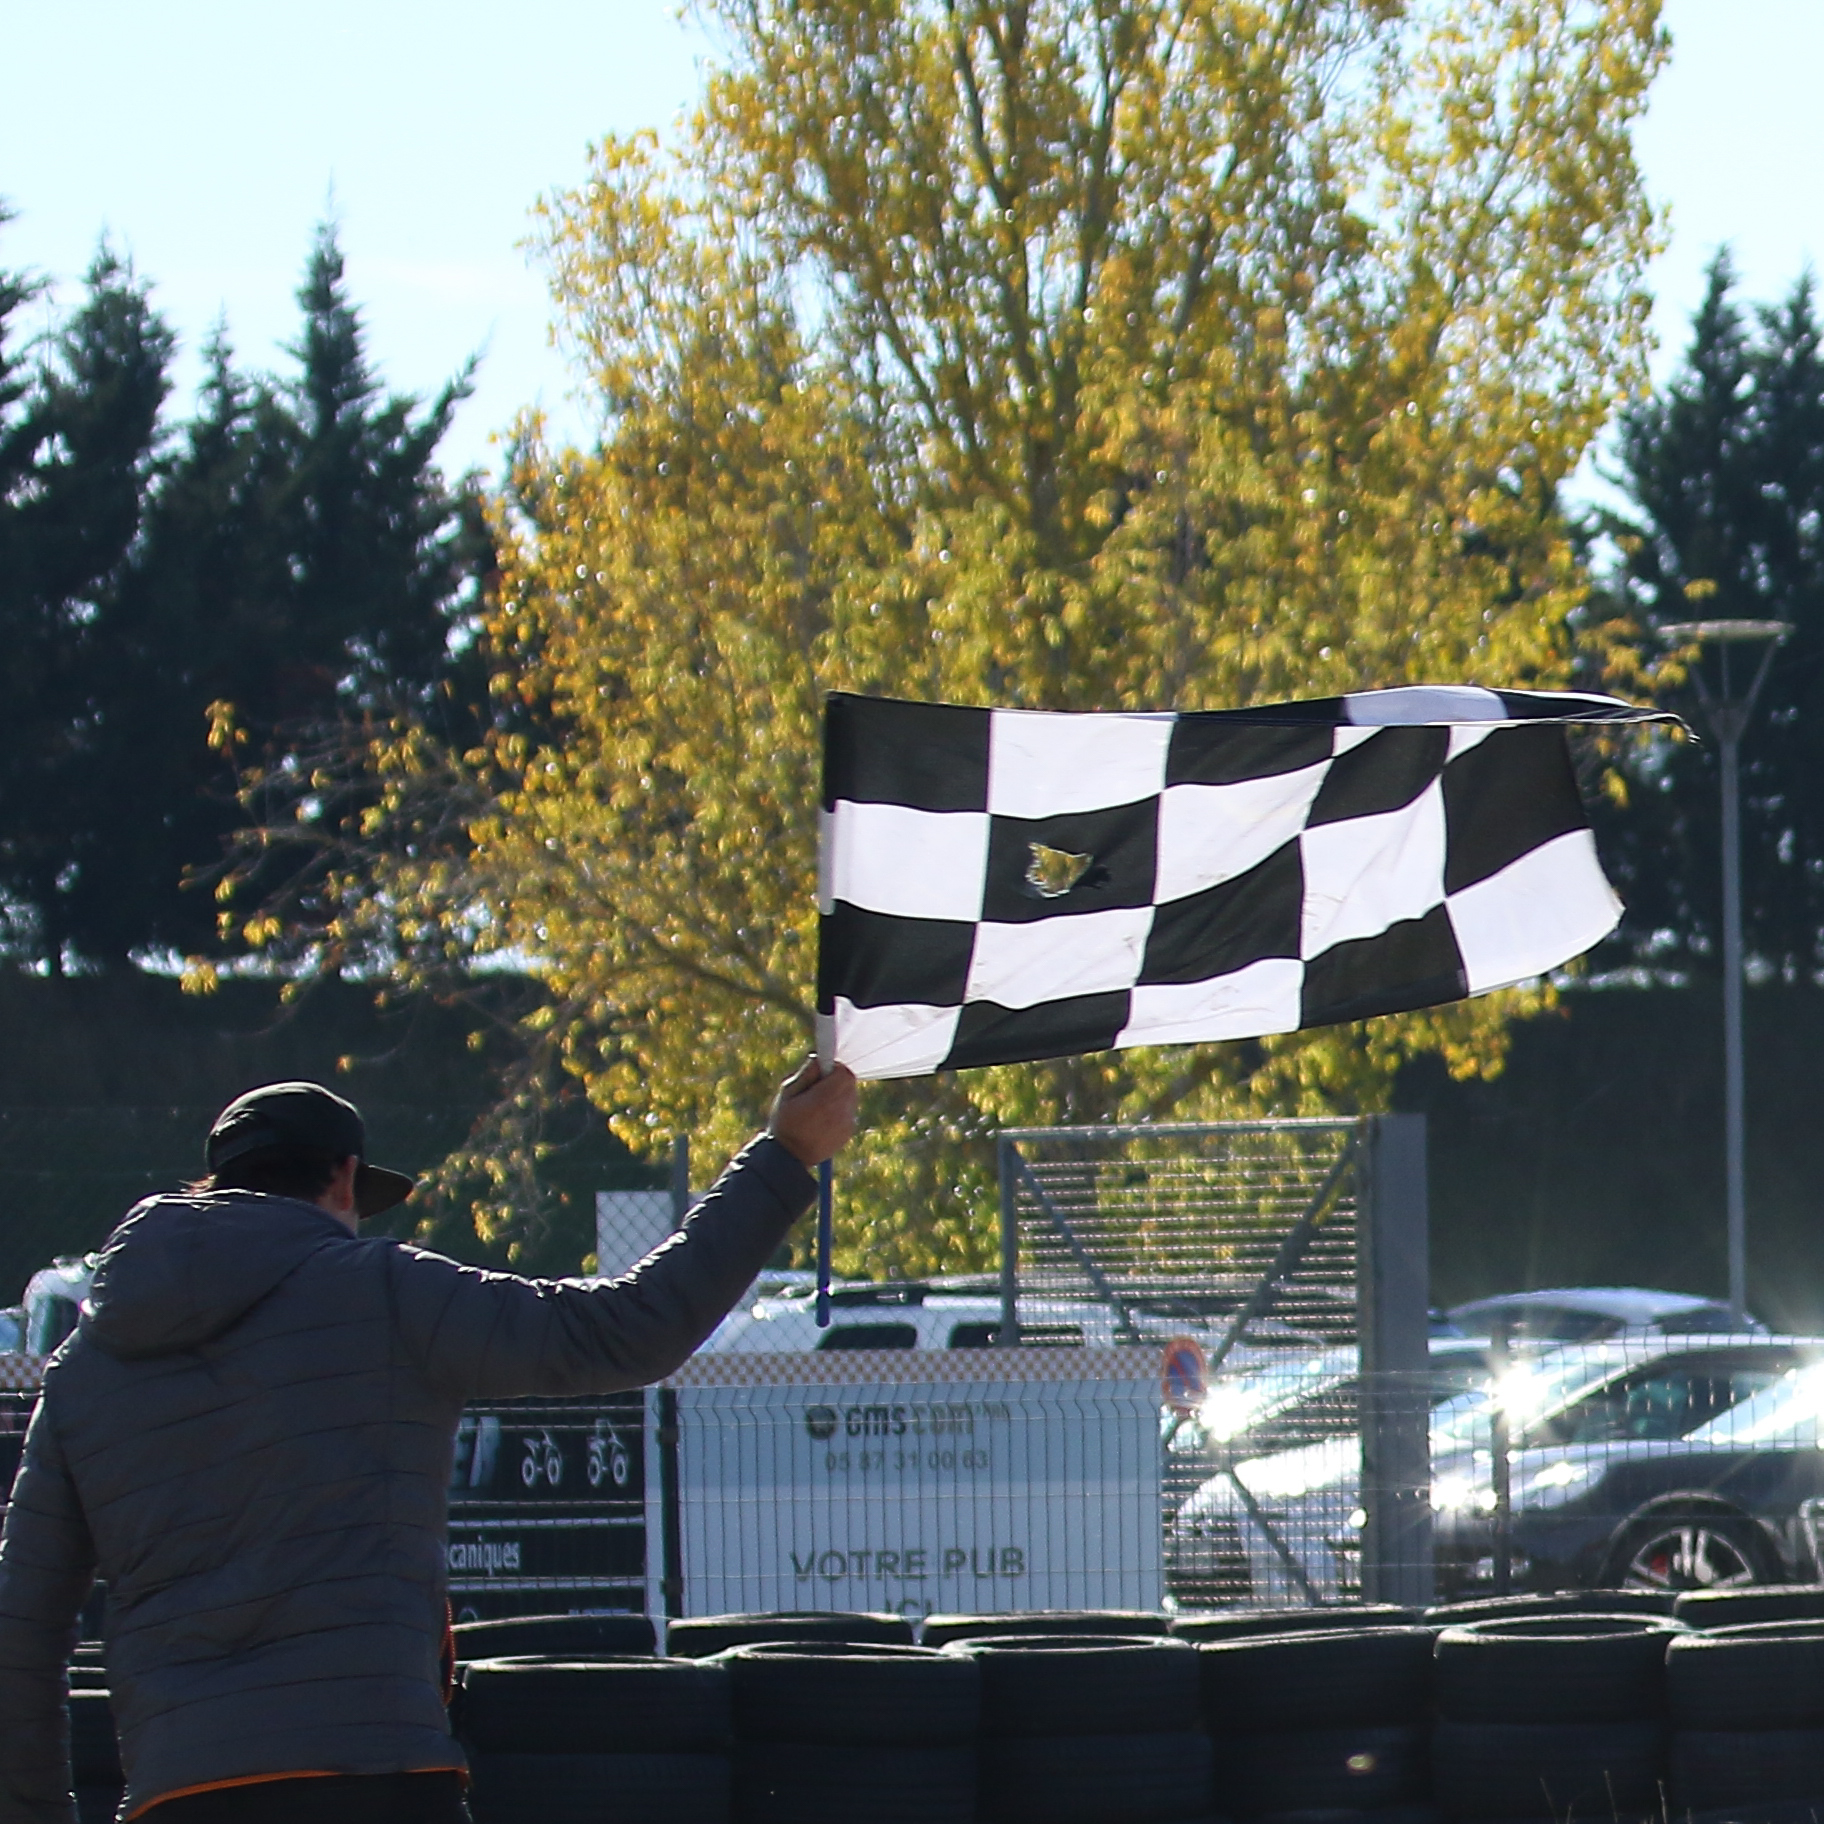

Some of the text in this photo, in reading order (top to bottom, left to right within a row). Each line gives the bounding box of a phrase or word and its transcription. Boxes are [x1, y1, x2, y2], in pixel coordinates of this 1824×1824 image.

[926, 1450, 955, 1472] 00
[450, 1535, 520, 1578] caniques
[789, 1546, 1025, 1581] VOTRE PUB
